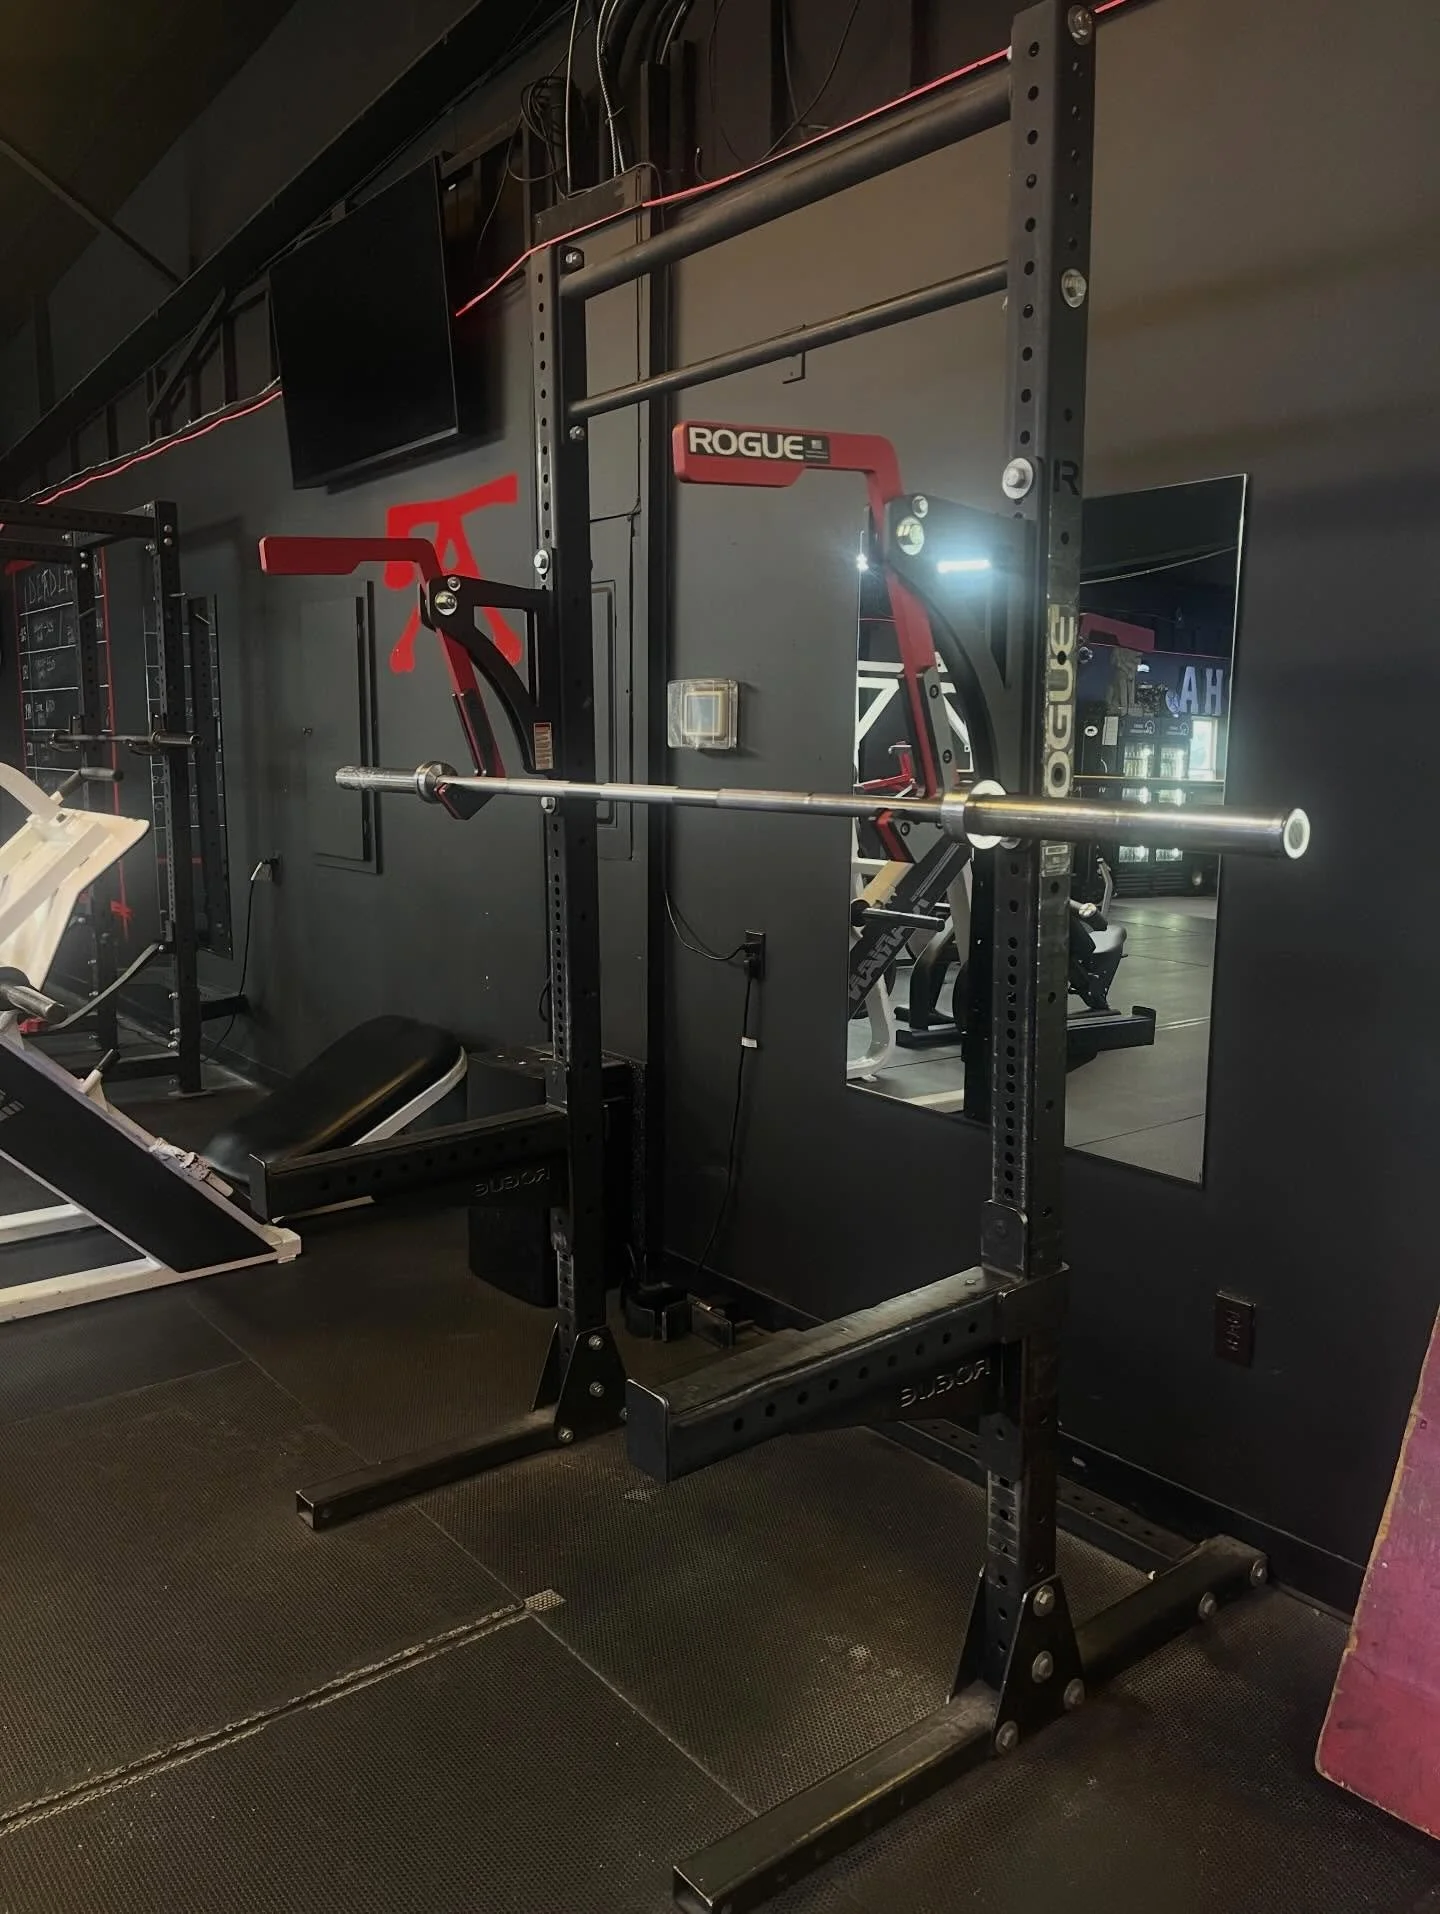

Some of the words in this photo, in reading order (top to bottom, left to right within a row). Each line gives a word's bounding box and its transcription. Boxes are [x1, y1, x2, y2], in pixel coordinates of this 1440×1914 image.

[688, 426, 804, 461] ROGUE
[1053, 459, 1080, 496] R
[1047, 606, 1076, 798] OGUE
